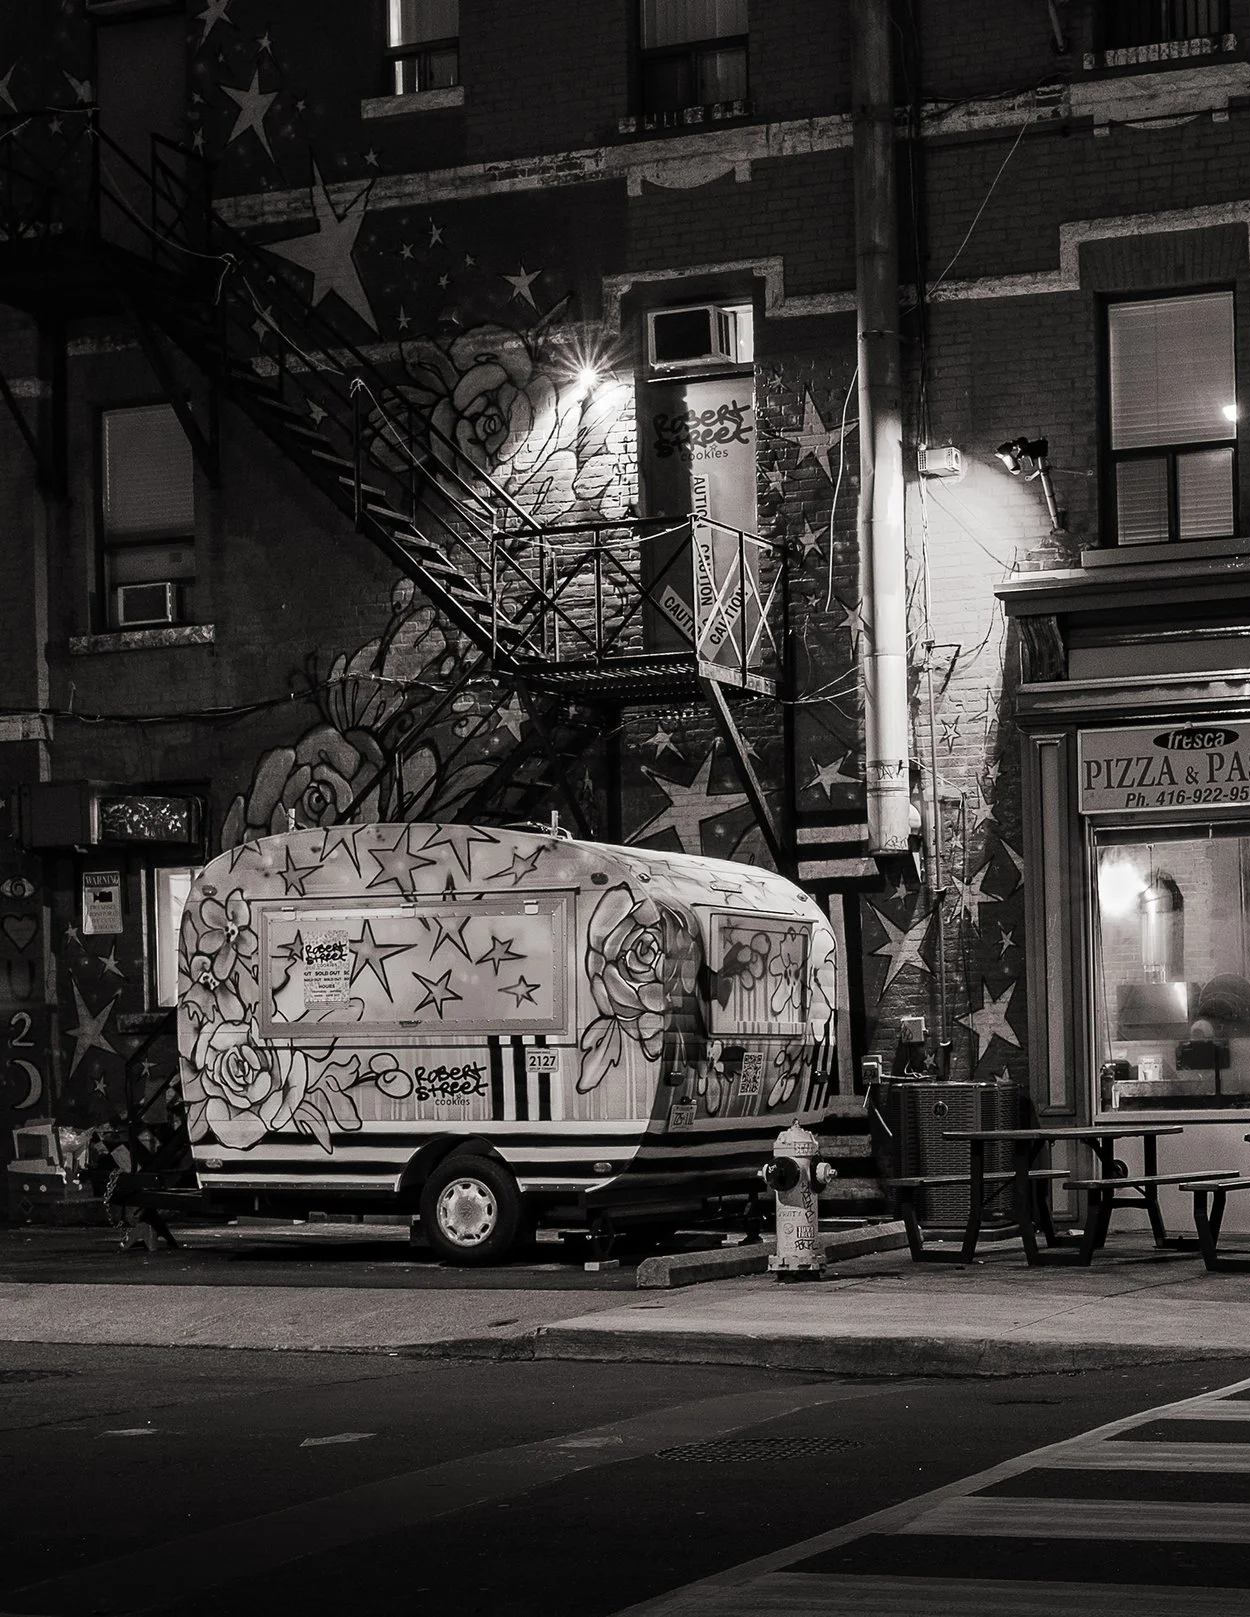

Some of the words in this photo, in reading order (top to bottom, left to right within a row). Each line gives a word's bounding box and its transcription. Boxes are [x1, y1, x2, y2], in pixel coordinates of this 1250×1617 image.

[681, 448, 728, 462] cookies
[1168, 732, 1226, 750] fresca
[1084, 756, 1178, 791] PIZZA
[1185, 766, 1200, 785] &
[1125, 793, 1150, 808] Ph.
[529, 1056, 556, 1067] 2127
[435, 1097, 470, 1106] cookies
